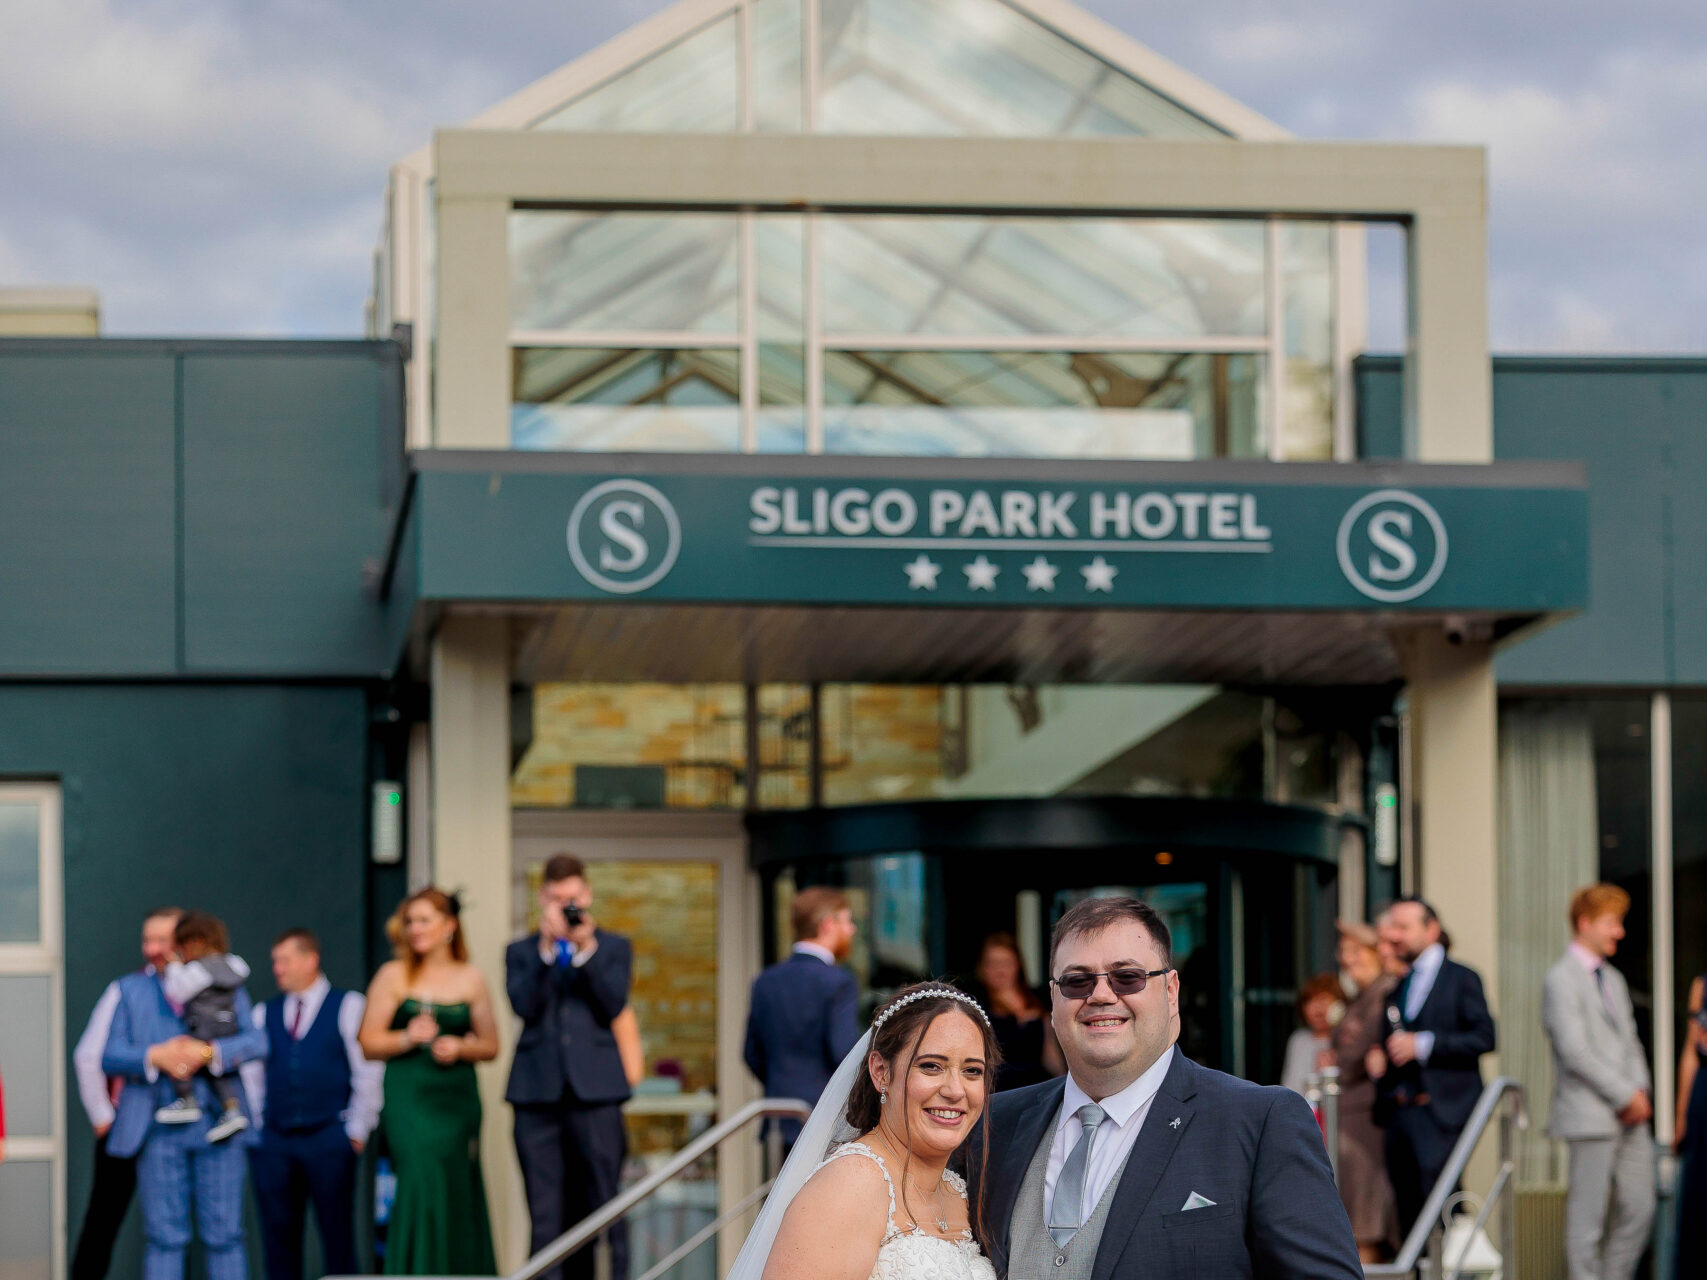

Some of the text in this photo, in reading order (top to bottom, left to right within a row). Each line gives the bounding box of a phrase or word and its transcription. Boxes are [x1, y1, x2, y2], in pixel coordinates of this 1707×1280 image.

[600, 500, 648, 572] S
[750, 487, 1272, 540] SLIGO PARK HOTEL
[1367, 510, 1417, 582] S
